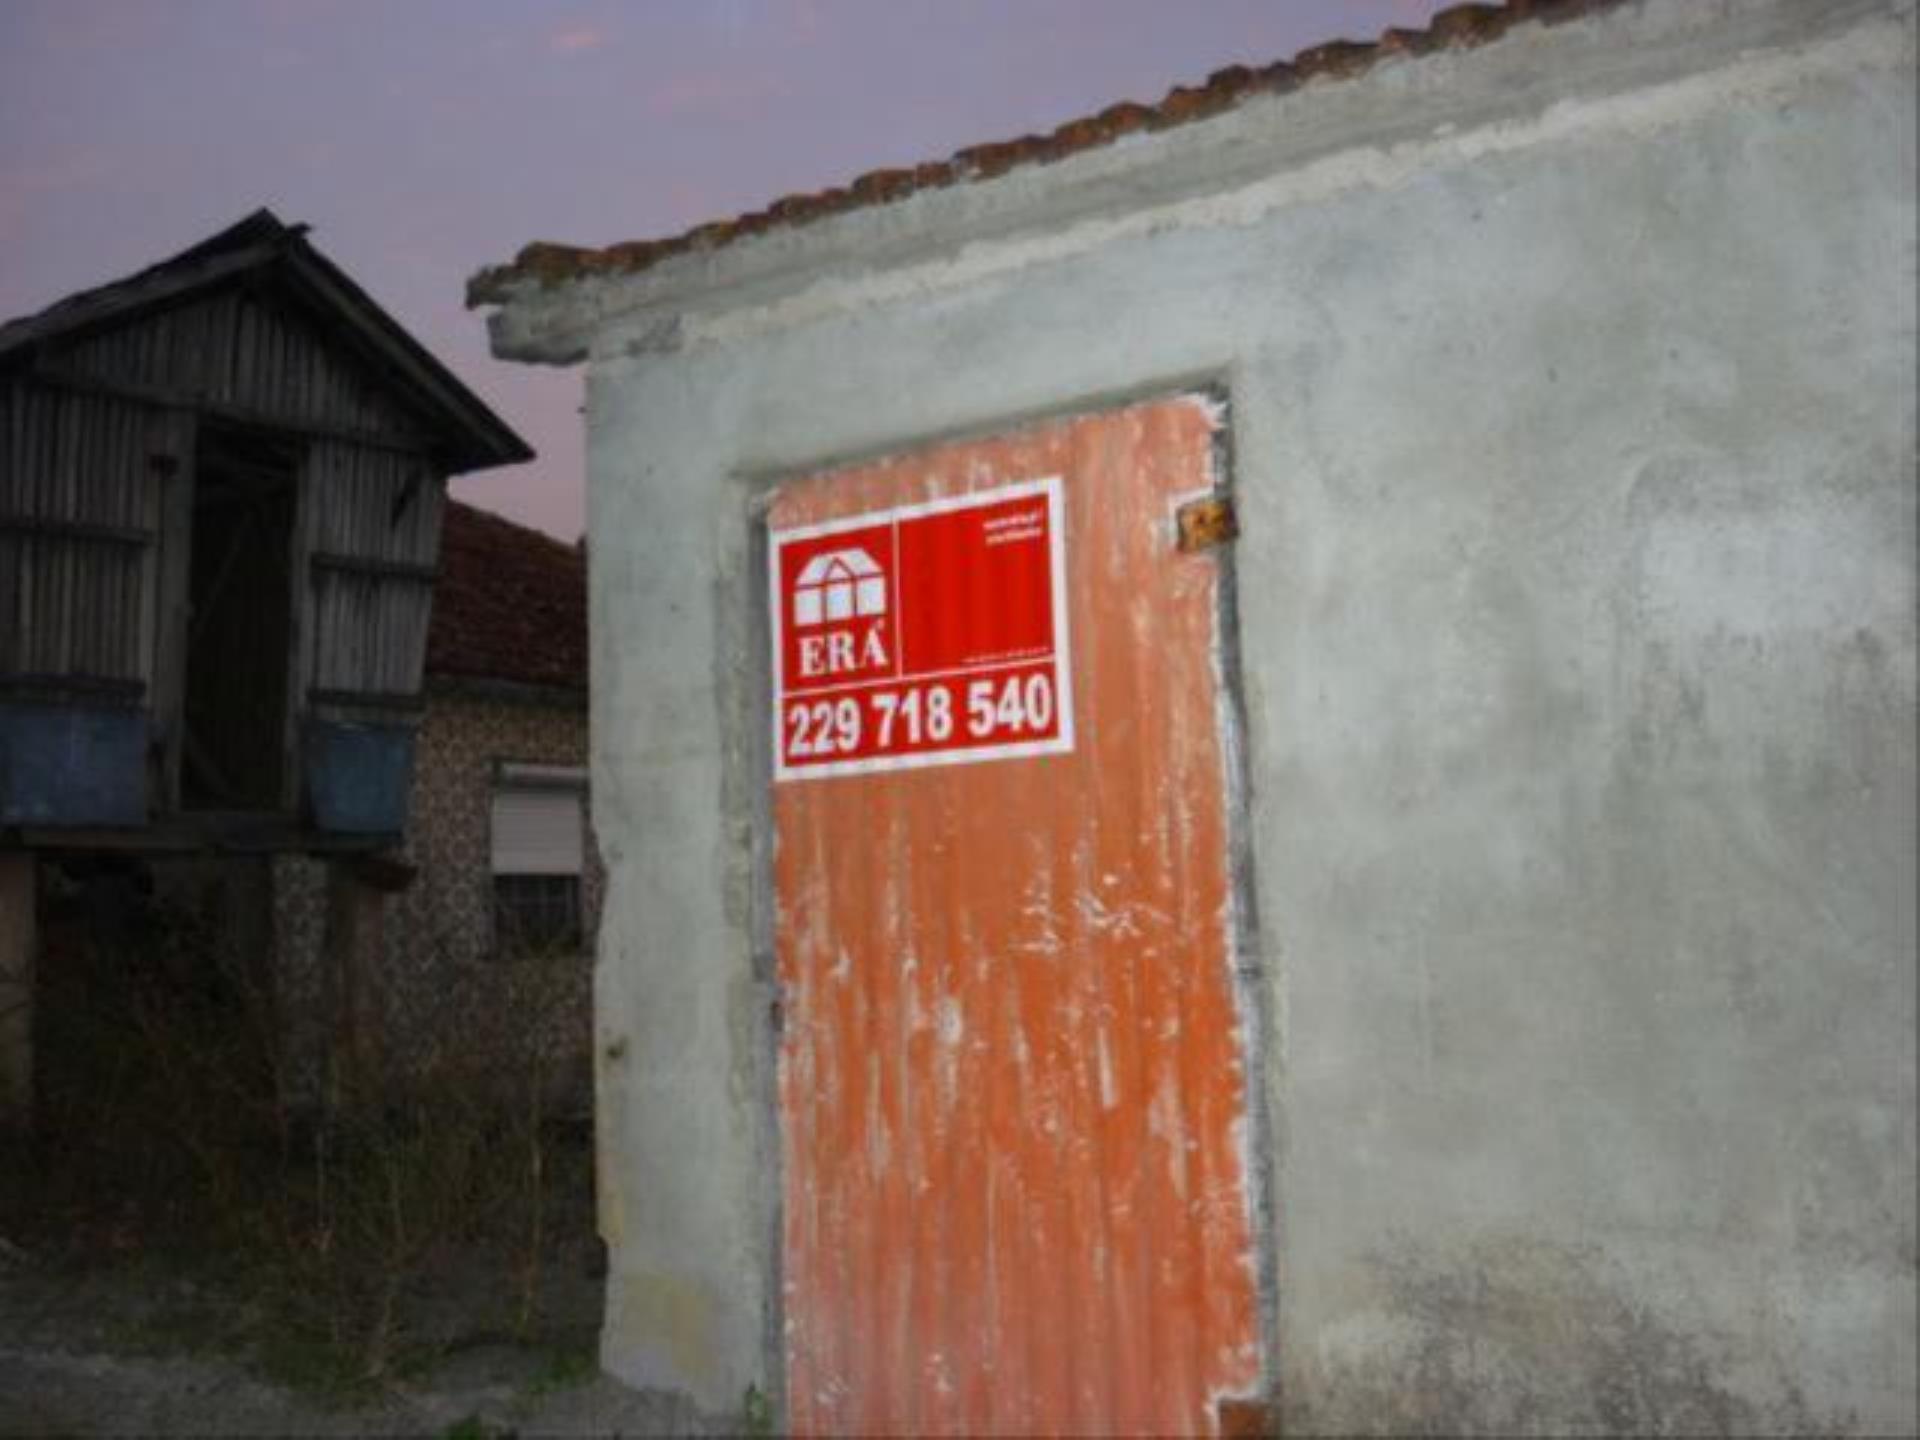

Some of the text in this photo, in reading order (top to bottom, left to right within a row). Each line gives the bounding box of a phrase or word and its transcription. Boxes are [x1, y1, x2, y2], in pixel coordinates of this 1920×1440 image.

[788, 674, 1051, 757] 229 718 540
